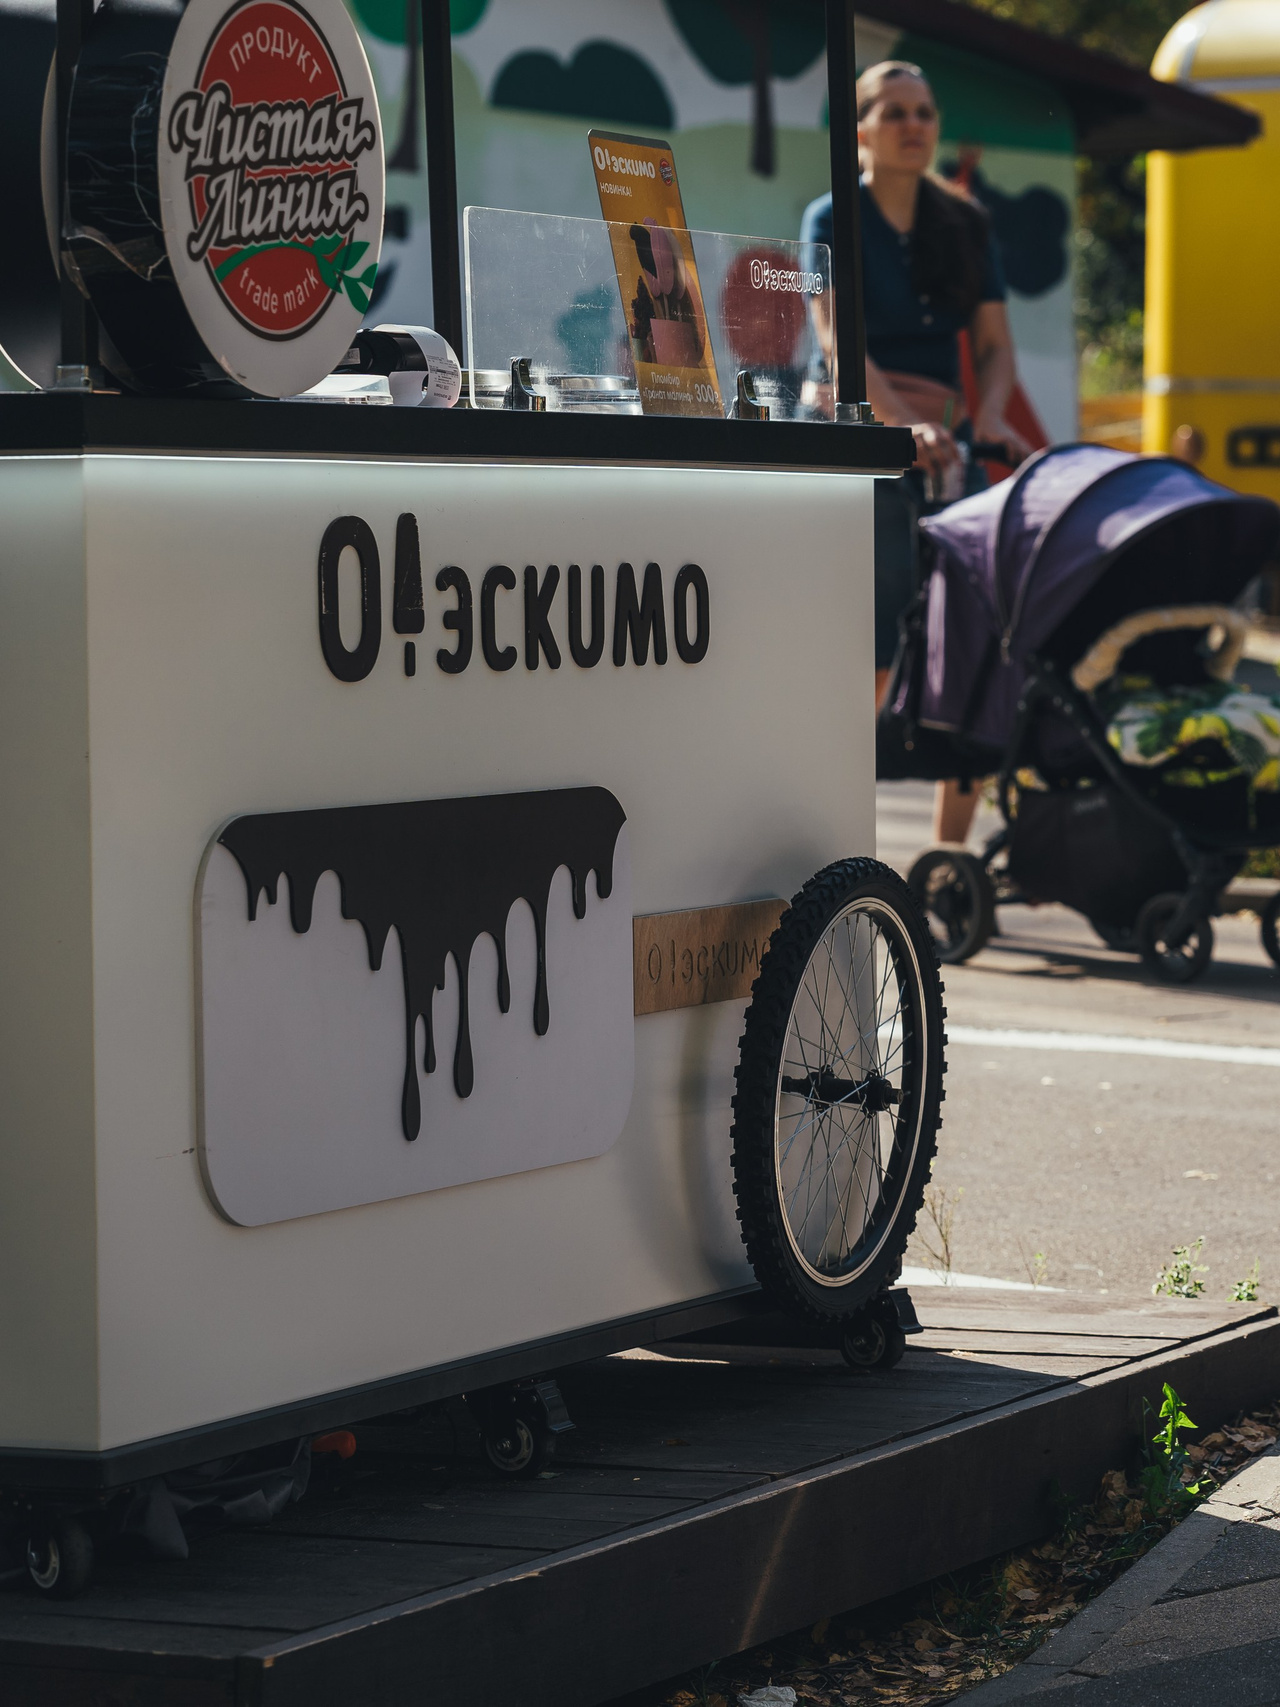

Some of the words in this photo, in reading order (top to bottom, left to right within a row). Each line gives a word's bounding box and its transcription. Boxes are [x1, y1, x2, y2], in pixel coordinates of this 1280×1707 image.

[229, 26, 322, 83] ПРОДУКТ
[169, 88, 373, 168] Чистая
[189, 169, 366, 254] Линия
[600, 182, 633, 197] НОВИНКА!
[239, 267, 279, 314] trade
[283, 268, 319, 313] mark
[651, 372, 680, 387] Пломбир
